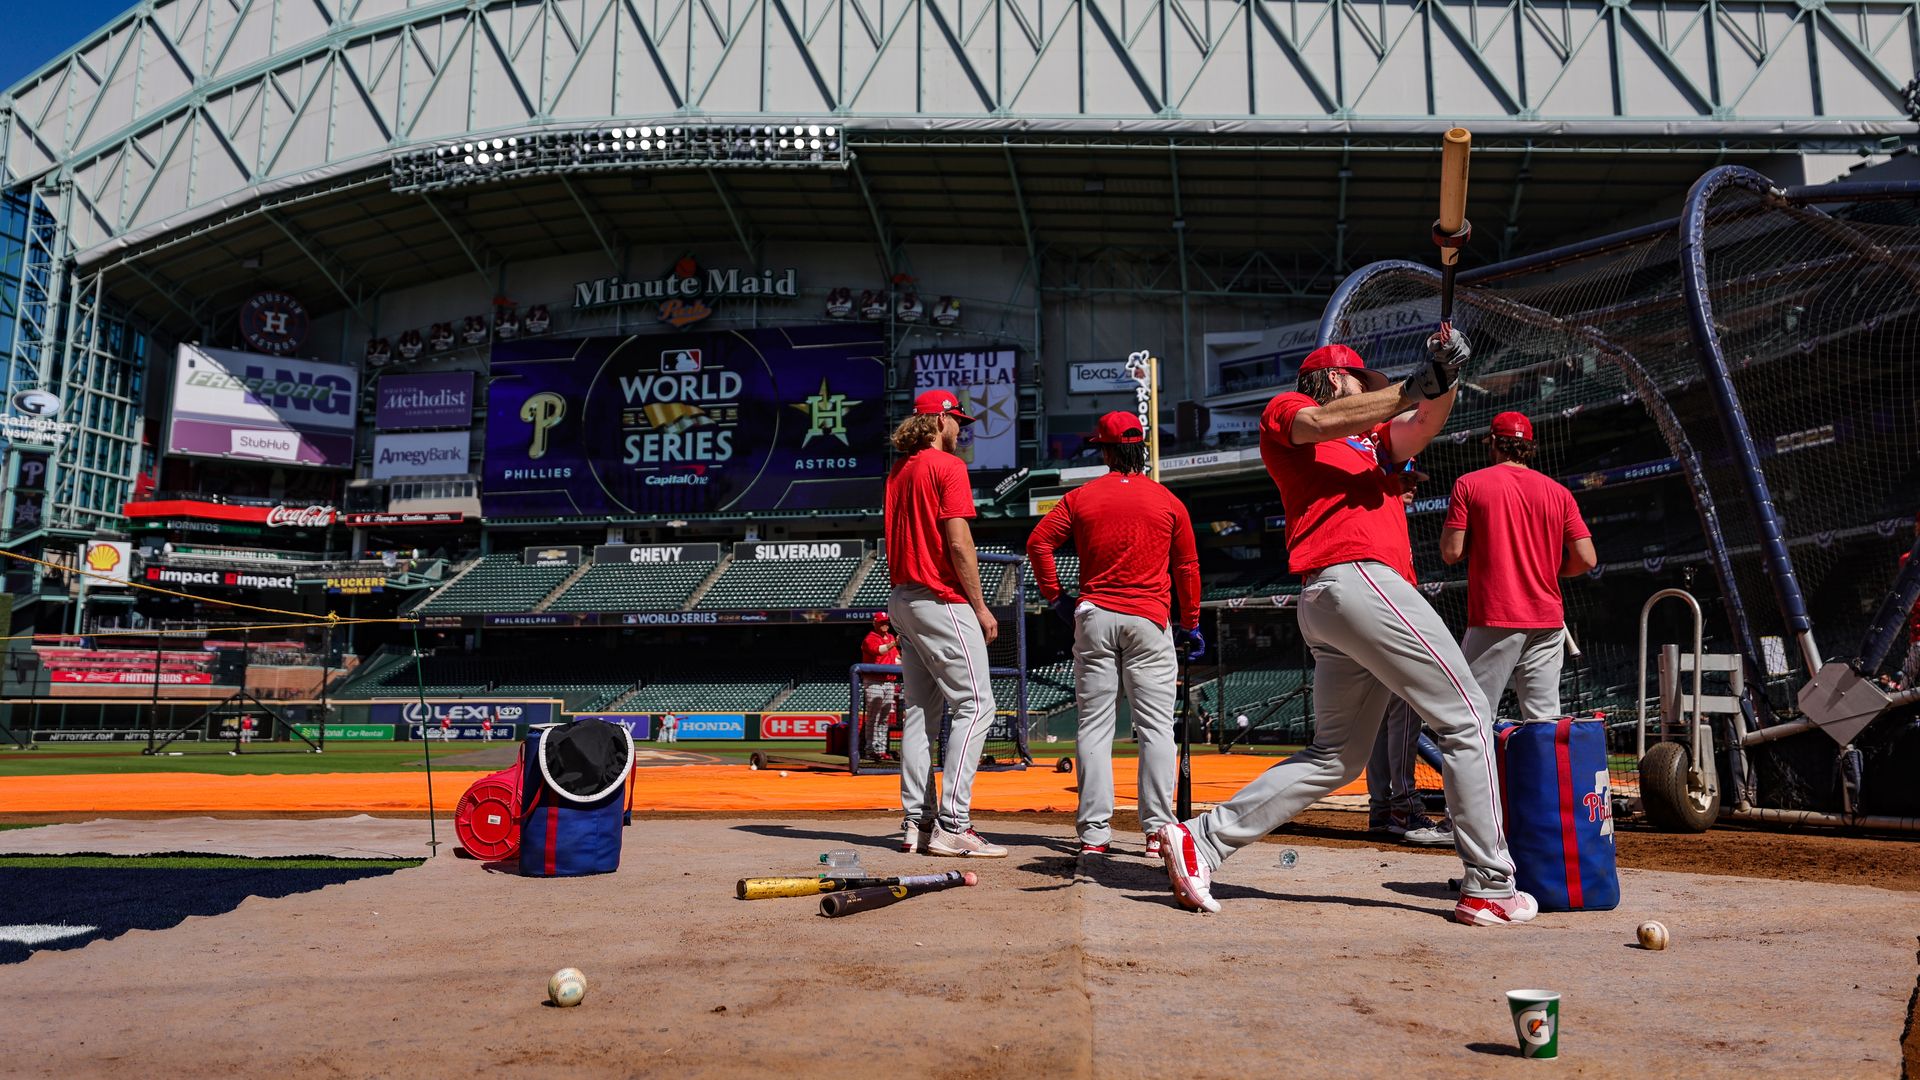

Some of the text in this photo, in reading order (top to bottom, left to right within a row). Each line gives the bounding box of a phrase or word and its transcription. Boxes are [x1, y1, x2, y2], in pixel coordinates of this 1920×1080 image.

[574, 268, 797, 308] Minute Maid
[251, 293, 304, 314] HOUSTON
[262, 311, 289, 335] H
[250, 333, 297, 351] ASTROS
[971, 351, 998, 369] TU
[1075, 364, 1119, 381] Texas
[188, 370, 330, 399] FREEPORT
[243, 365, 352, 416] LNG
[619, 371, 743, 404] WORLD
[383, 389, 467, 409] Methodist
[0, 413, 75, 433] Gallagher
[2, 429, 66, 443] INSURANCE
[239, 435, 290, 451] StubHub
[623, 430, 733, 465] SERIES
[379, 447, 461, 466] AmegyBank
[794, 457, 858, 470] ASTROS
[1162, 456, 1218, 468] ULTRA CLUB
[504, 467, 572, 481] PHILLIES
[167, 519, 220, 533] HORNITOS
[629, 547, 683, 562] CHEVY
[754, 543, 842, 560] SILVERADO
[160, 567, 294, 588] impact impact
[327, 577, 385, 588] PLUCKERS
[494, 616, 557, 625] PHILADELPHIA
[637, 613, 680, 625] WORLD
[681, 612, 717, 624] SERIES
[311, 728, 343, 737] Naional
[682, 721, 742, 732] HONDA
[1518, 1010, 1551, 1045] G
